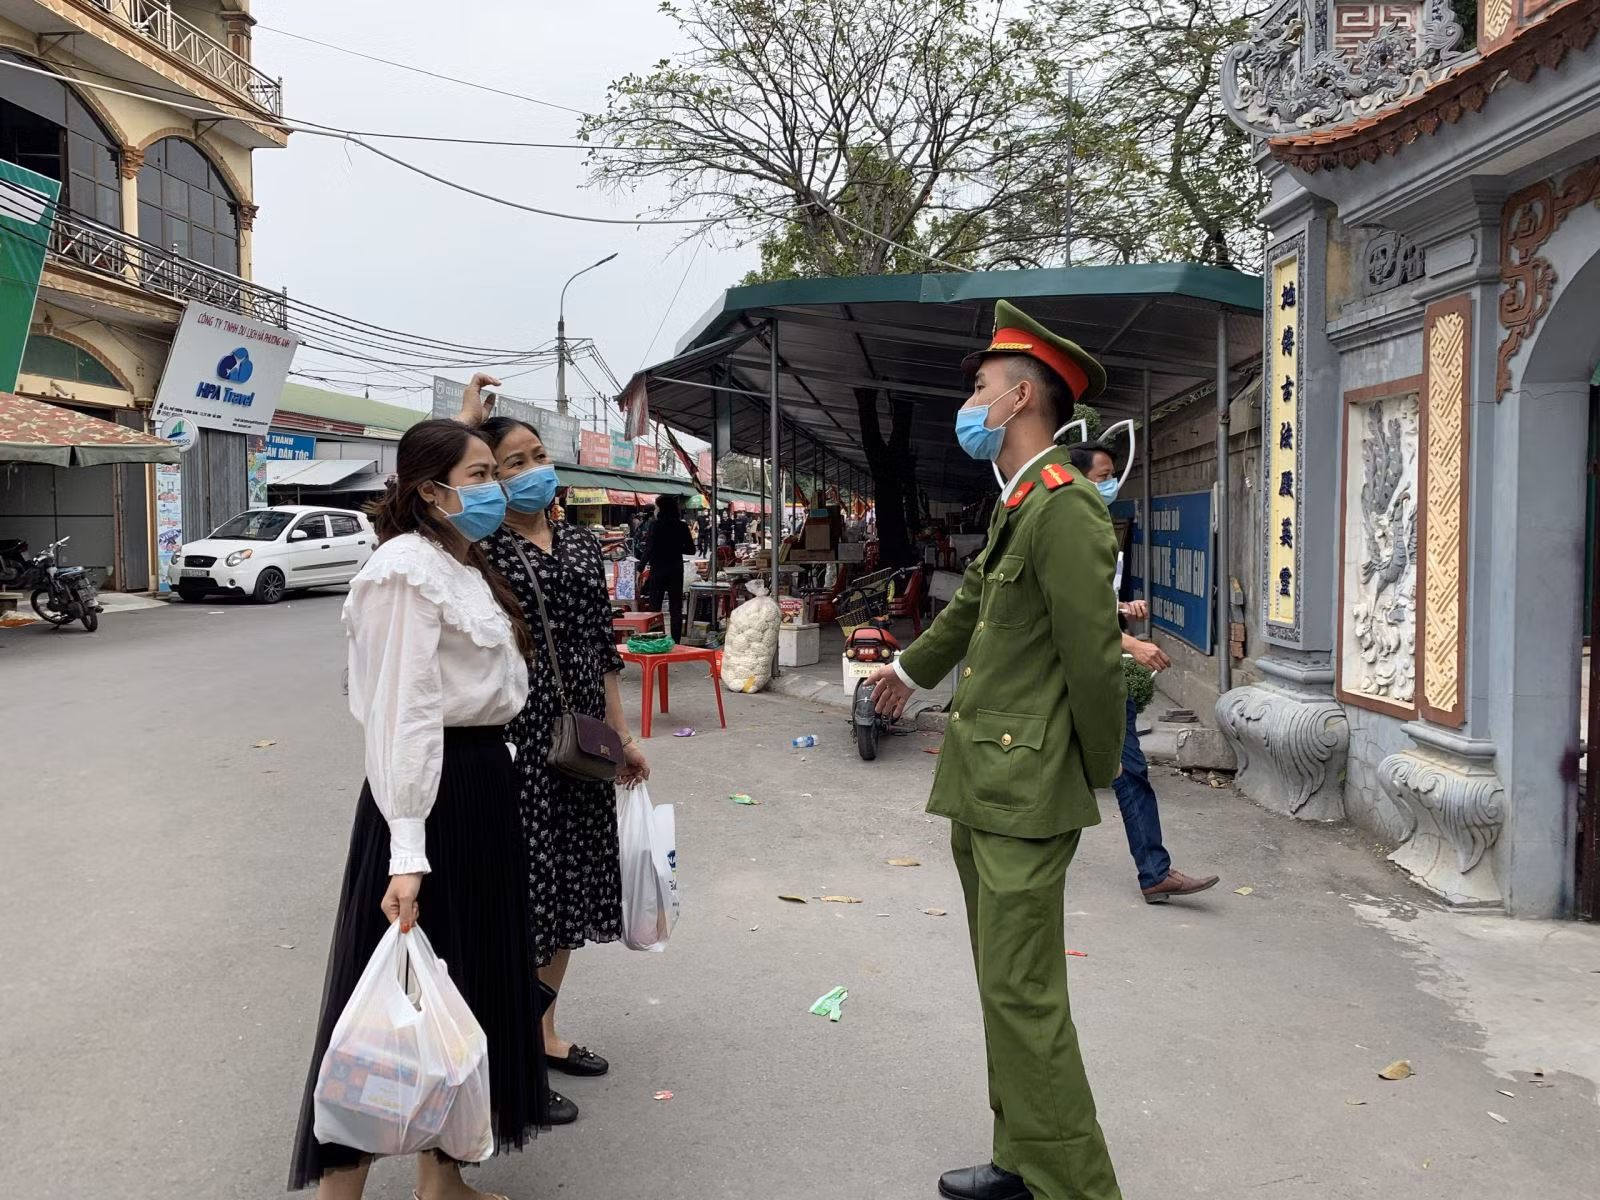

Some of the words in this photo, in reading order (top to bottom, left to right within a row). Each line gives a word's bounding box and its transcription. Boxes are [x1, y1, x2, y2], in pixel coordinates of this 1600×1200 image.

[198, 312, 214, 326] CÔNG
[214, 318, 223, 328] TY
[223, 320, 239, 333] TNHH
[238, 325, 247, 336] DU
[196, 382, 222, 401] HPA
[223, 387, 255, 407] Travel
